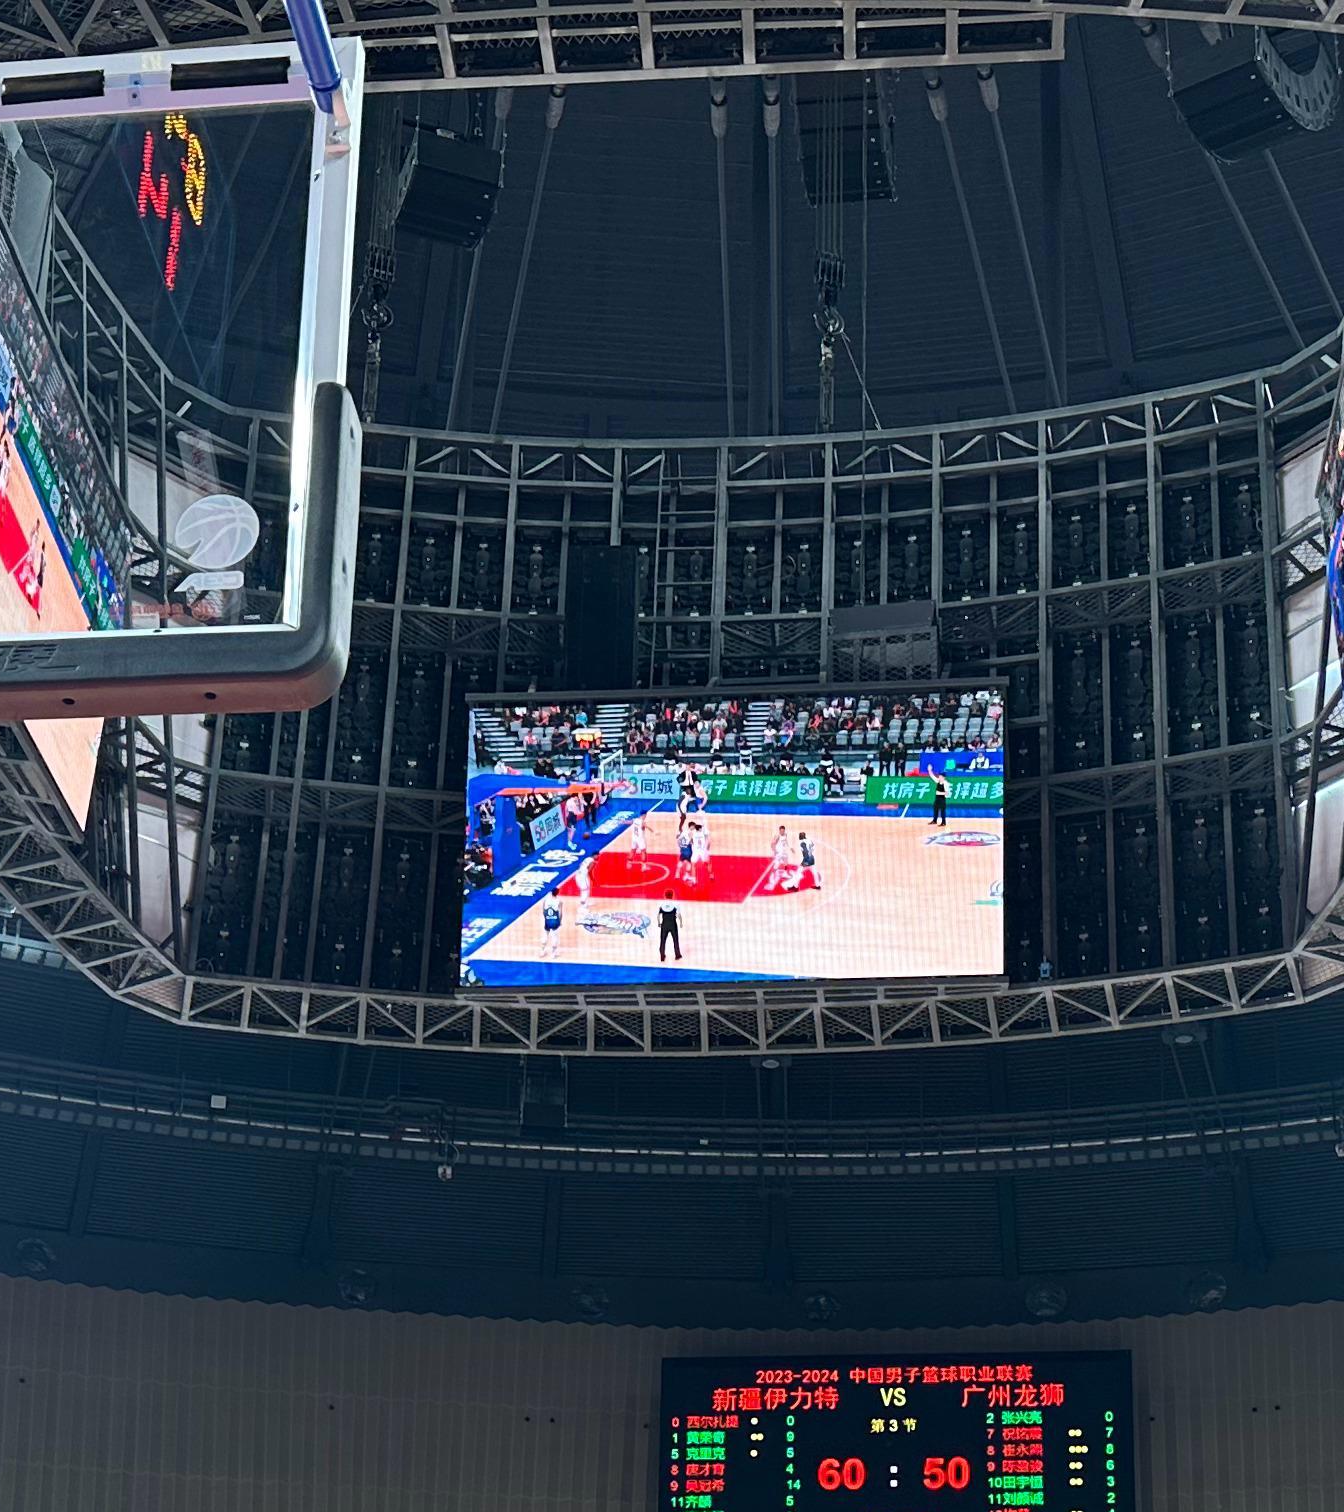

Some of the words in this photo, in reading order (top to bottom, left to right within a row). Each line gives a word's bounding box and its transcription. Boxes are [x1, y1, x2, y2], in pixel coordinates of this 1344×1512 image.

[732, 779, 793, 797] 选择超多
[883, 781, 932, 800] 找房子
[756, 1369, 839, 1384] 2023-2024
[849, 1365, 1033, 1384] 中国男子篮球职业联赛
[712, 1386, 840, 1411] 新疆伊力特
[880, 1387, 907, 1407] VS
[961, 1383, 1065, 1408] 广州龙狮
[818, 1457, 865, 1490] 60
[922, 1456, 971, 1490] 50
